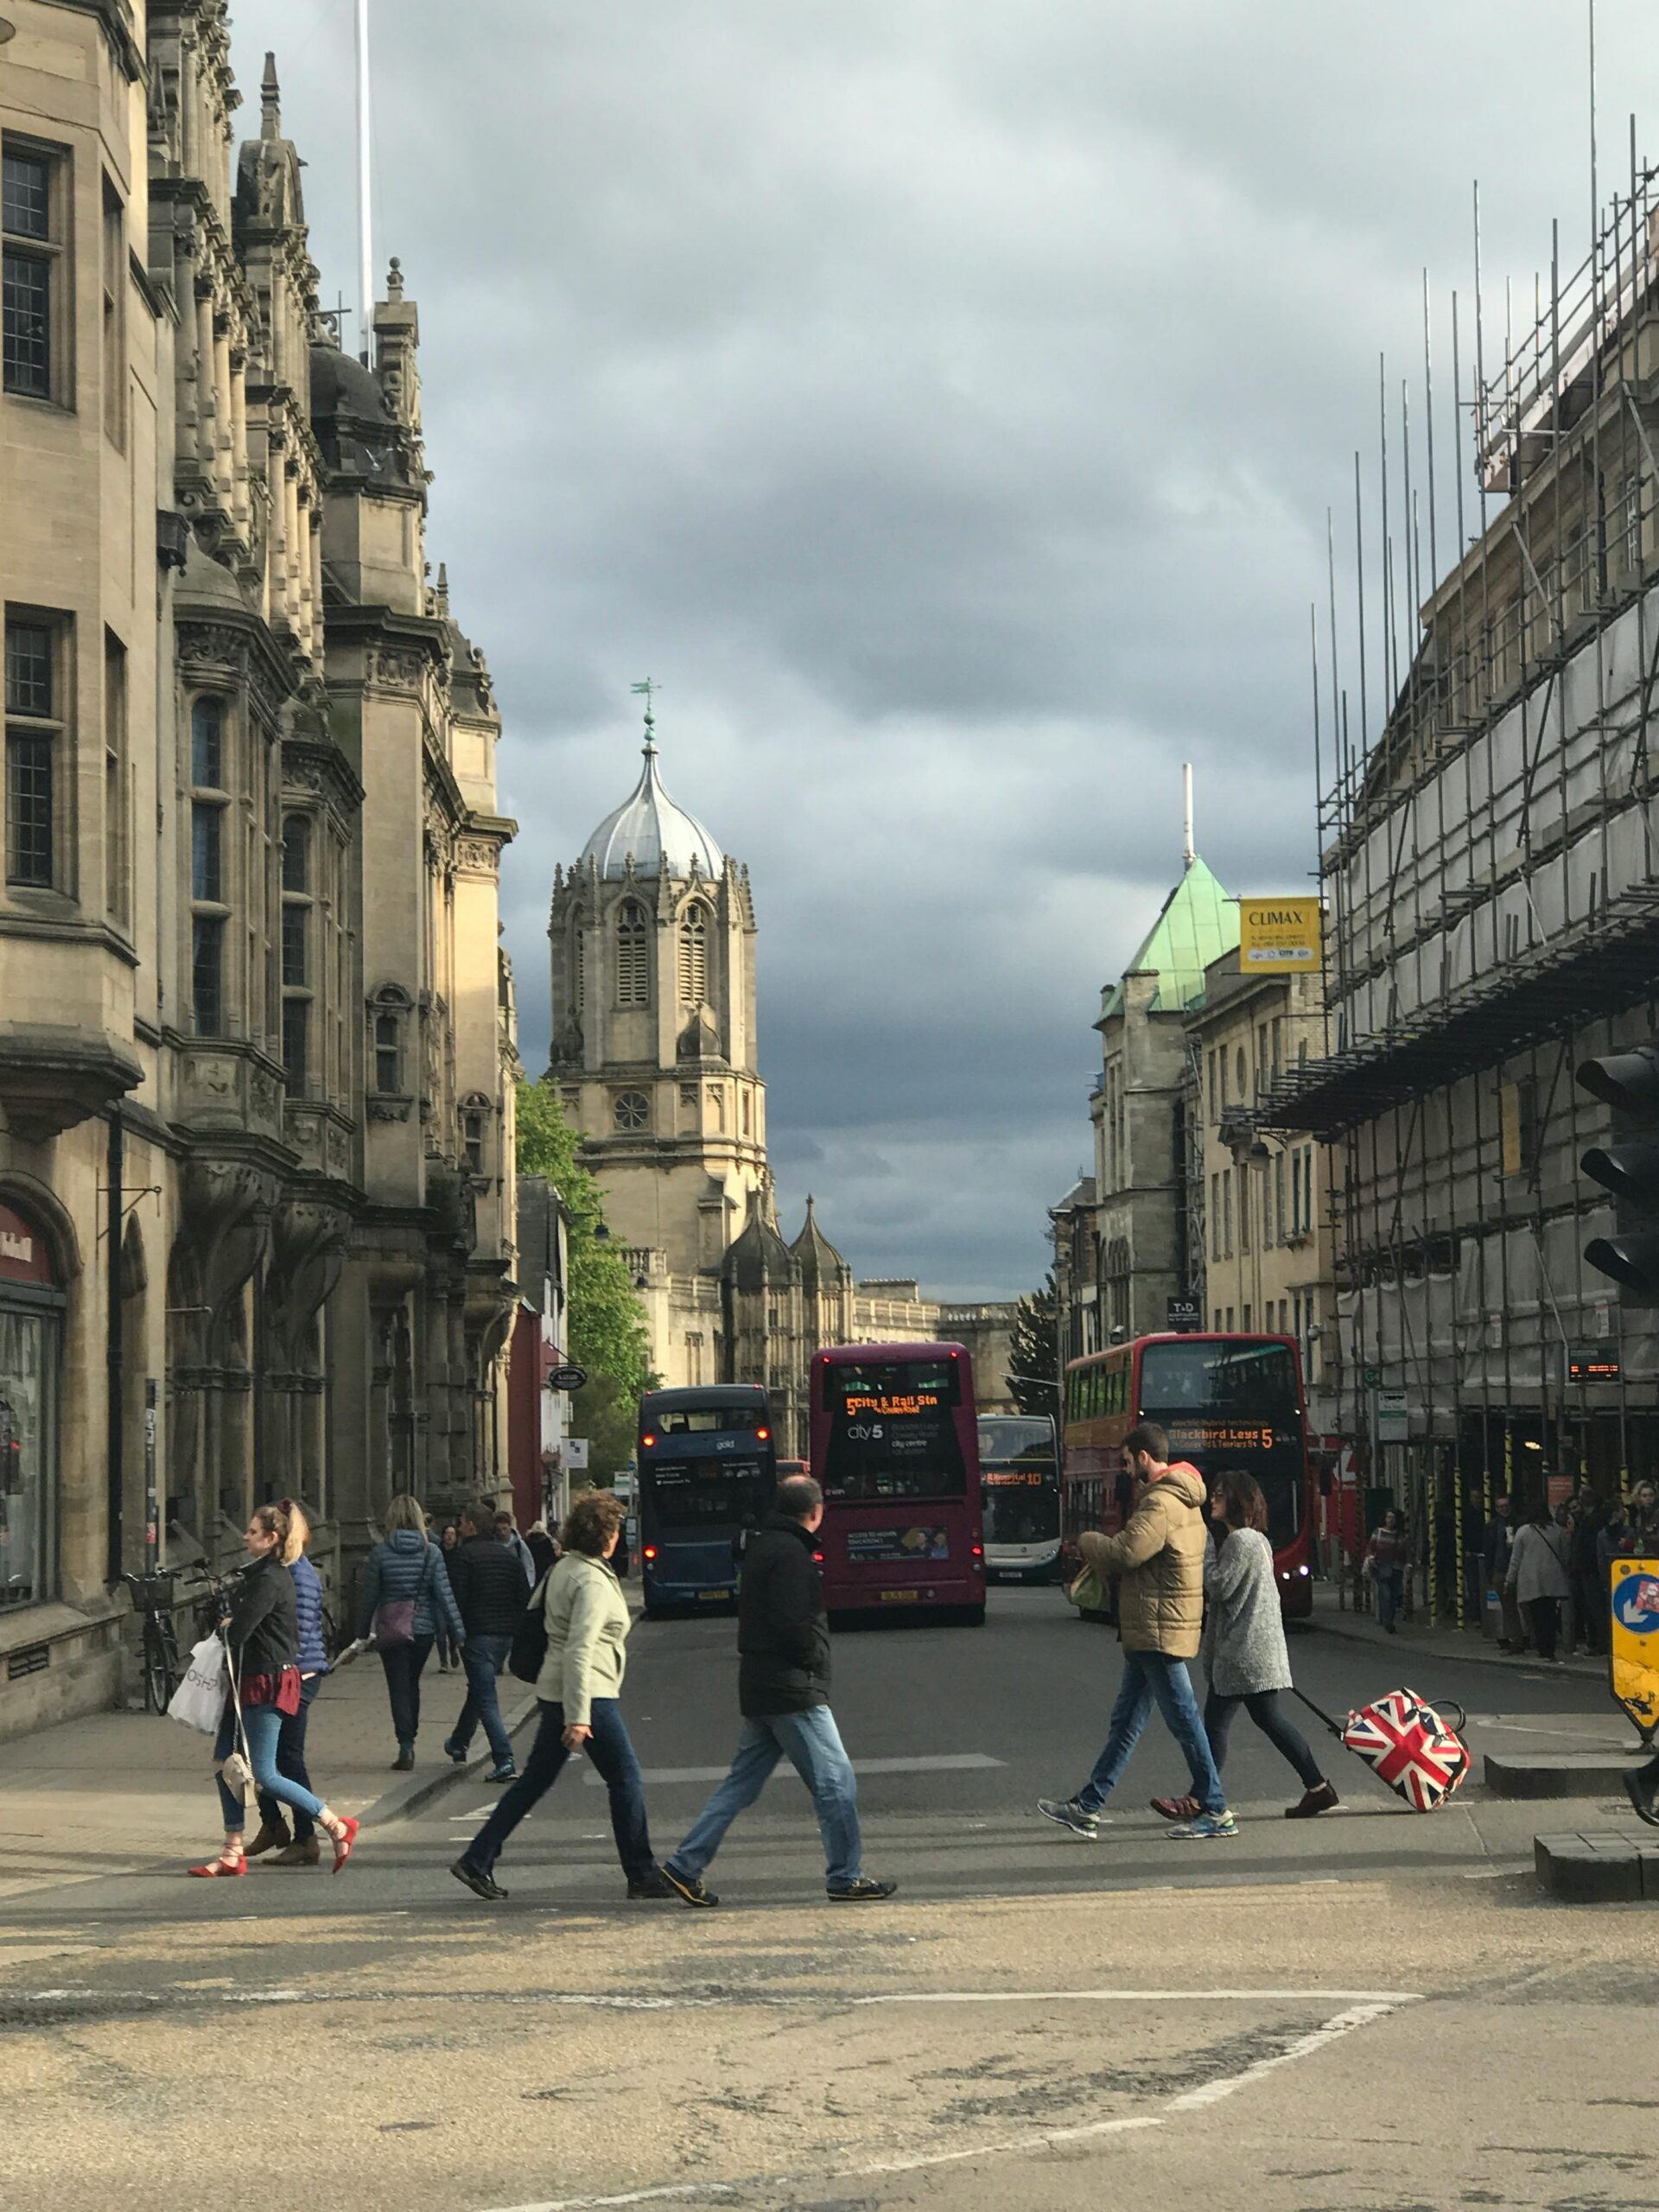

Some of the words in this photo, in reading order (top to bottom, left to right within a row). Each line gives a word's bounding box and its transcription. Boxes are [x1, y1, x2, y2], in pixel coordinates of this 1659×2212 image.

[1249, 911, 1302, 925] CLIMAX
[846, 1397, 856, 1415] 5
[880, 1396, 889, 1408] &
[892, 1395, 915, 1407] Rail
[917, 1395, 938, 1406] Stn
[1168, 1428, 1227, 1440] Blackbird
[1230, 1428, 1259, 1440] Leys
[1262, 1428, 1274, 1449] 5
[1027, 1472, 1042, 1484] 10
